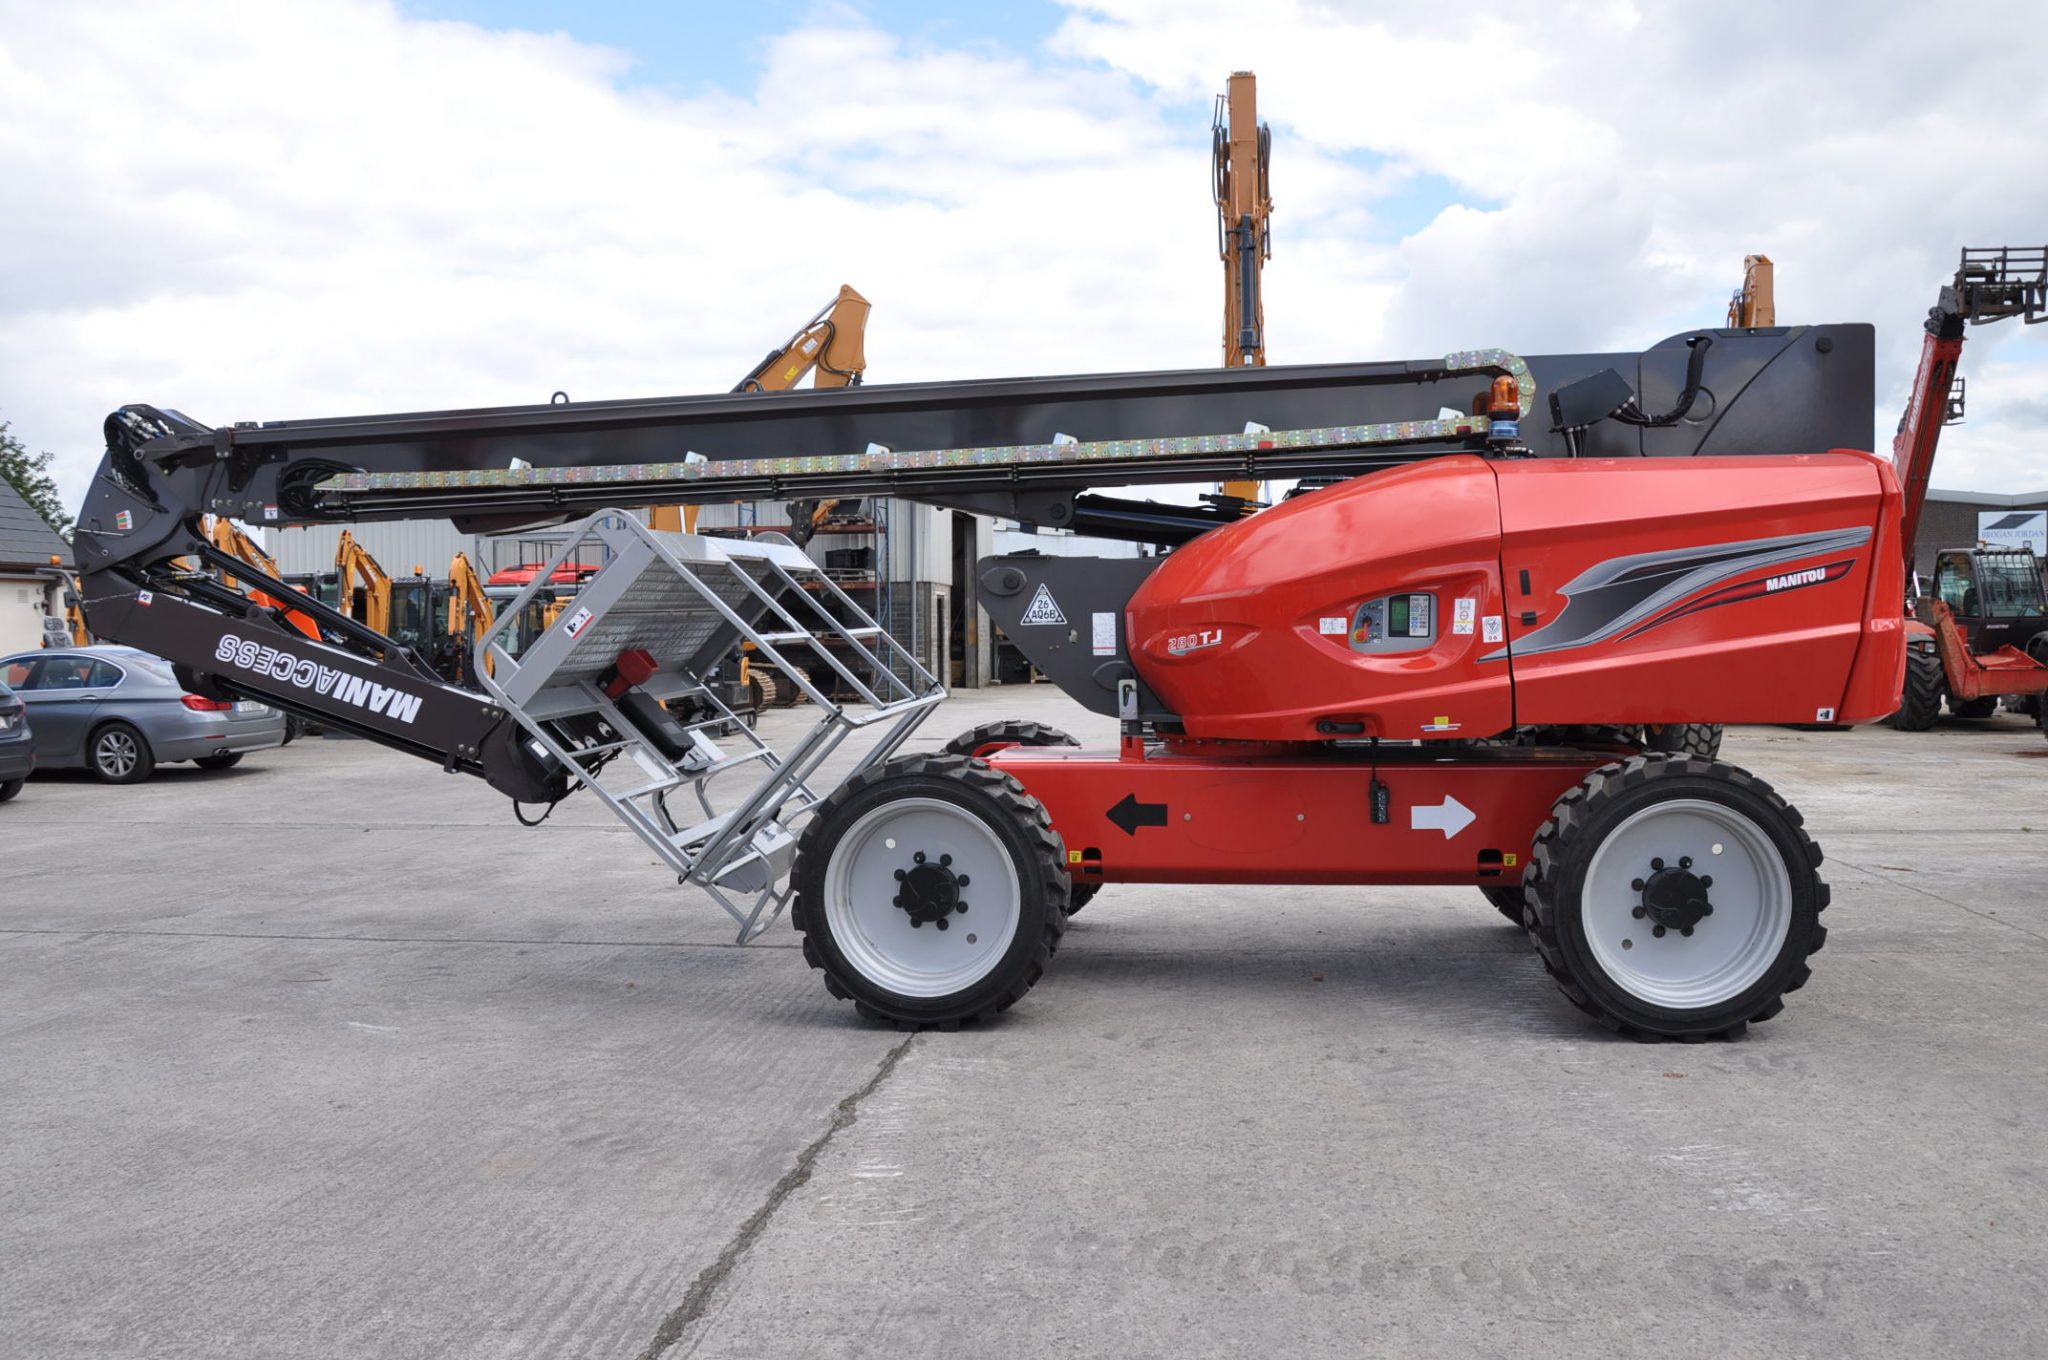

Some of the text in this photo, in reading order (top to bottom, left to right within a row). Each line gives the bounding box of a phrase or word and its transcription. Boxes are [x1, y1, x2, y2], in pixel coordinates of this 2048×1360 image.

[1766, 568, 1826, 591] MANITOU
[1037, 600, 1050, 609] 26
[1199, 629, 1222, 645] TJ
[215, 635, 424, 724] MANIACCESS
